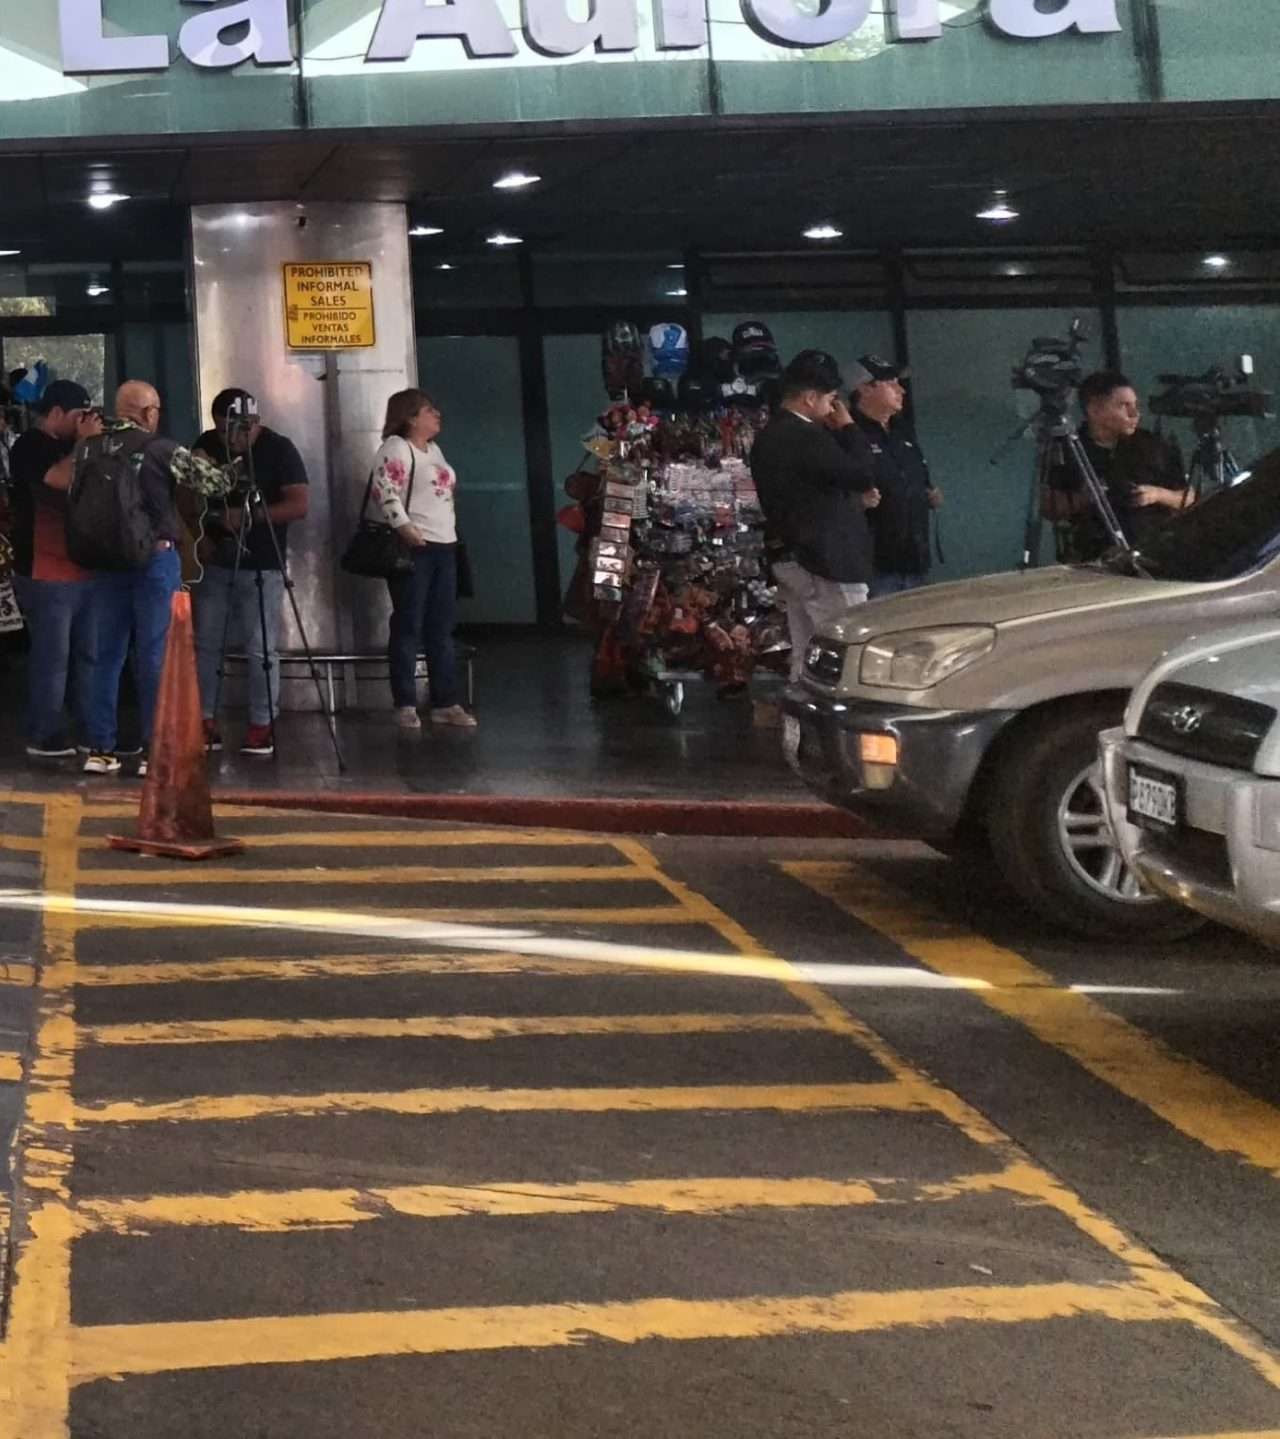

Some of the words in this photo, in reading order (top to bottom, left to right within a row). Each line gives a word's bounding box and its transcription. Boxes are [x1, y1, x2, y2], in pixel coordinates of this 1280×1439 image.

[291, 266, 362, 278] PROHIBITED
[297, 281, 359, 291] INFORMAL
[311, 295, 346, 306] SALES
[303, 312, 356, 321] PROHIBIDO
[312, 323, 349, 332] VENTAS
[301, 335, 361, 344] INFORMALES
